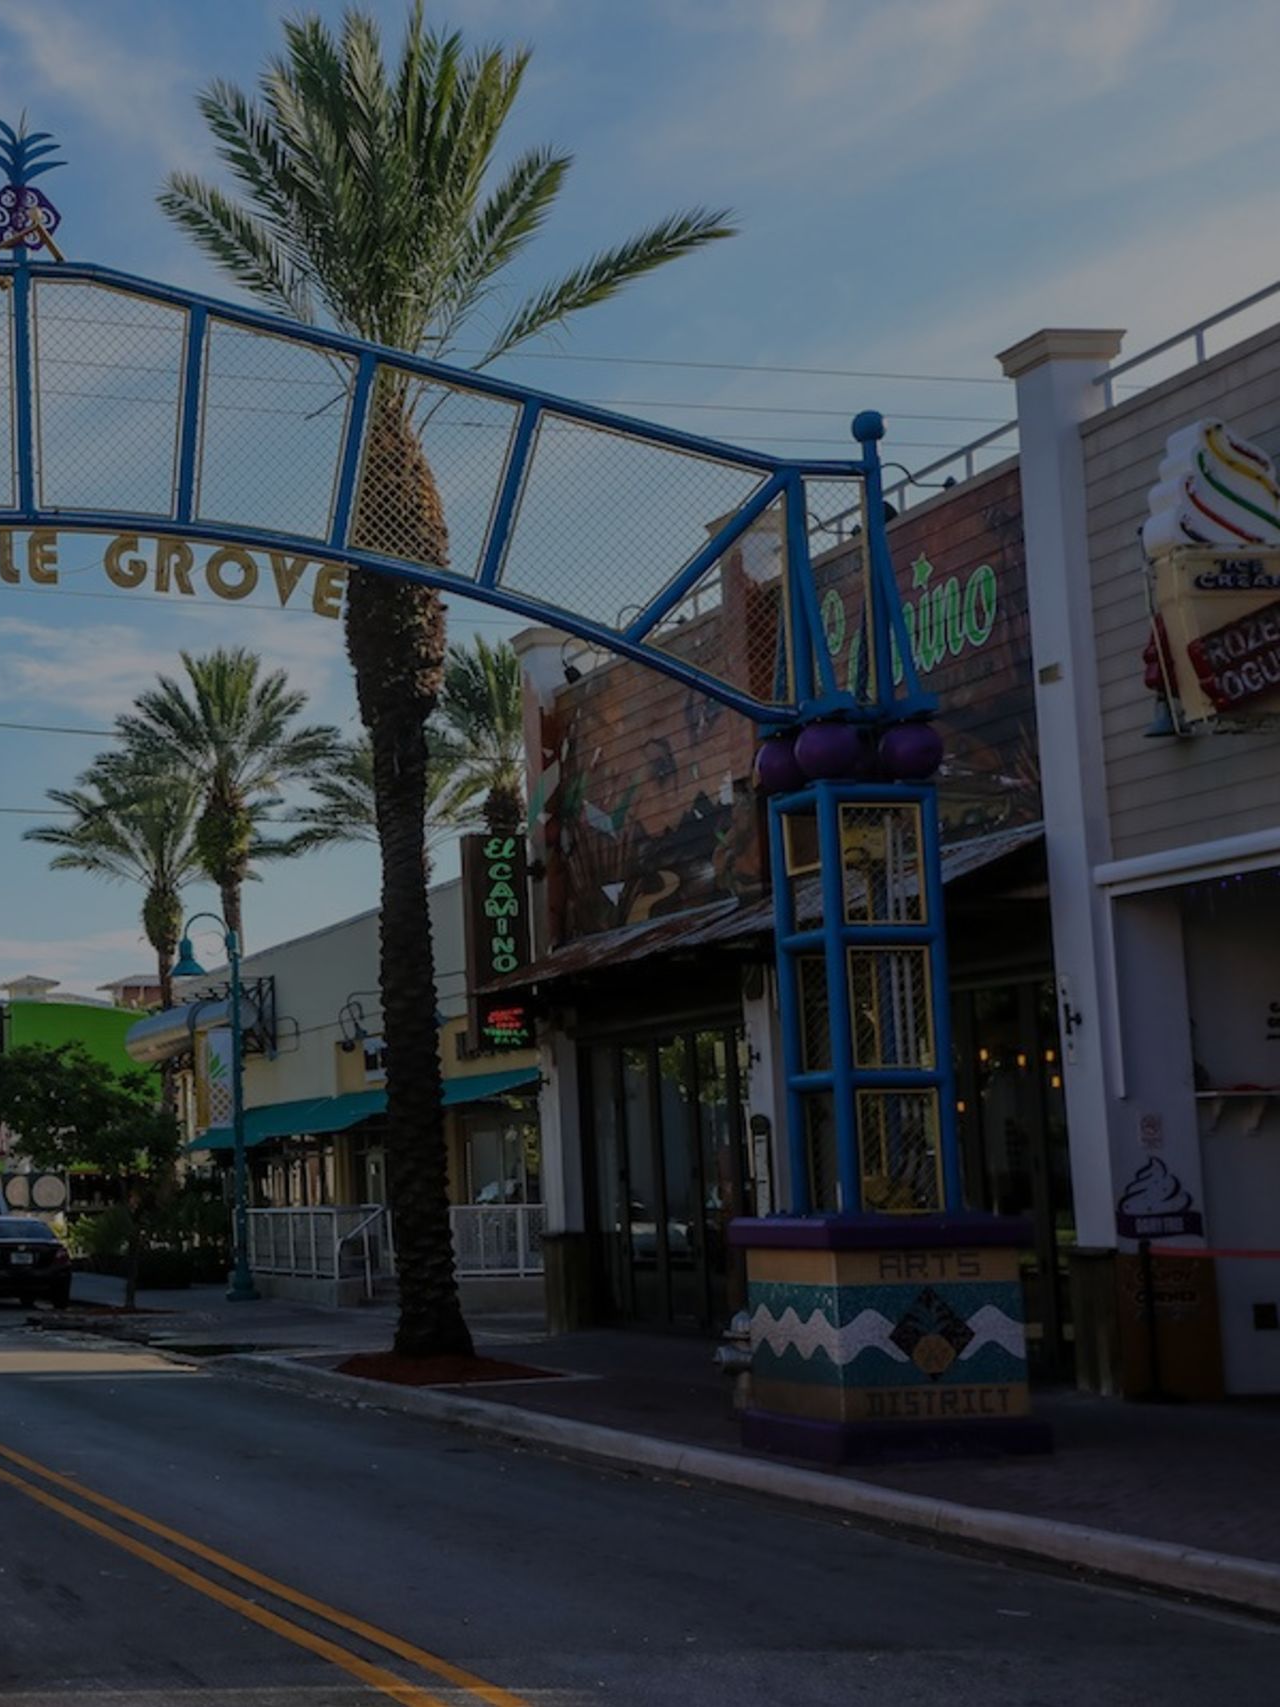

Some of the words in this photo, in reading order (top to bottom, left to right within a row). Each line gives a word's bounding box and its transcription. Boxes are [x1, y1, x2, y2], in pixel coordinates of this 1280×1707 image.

[105, 536, 349, 620] GROVE
[483, 862, 520, 973] CAMINO
[879, 1252, 981, 1279] ARTS
[868, 1388, 1010, 1416] DISTRICT
